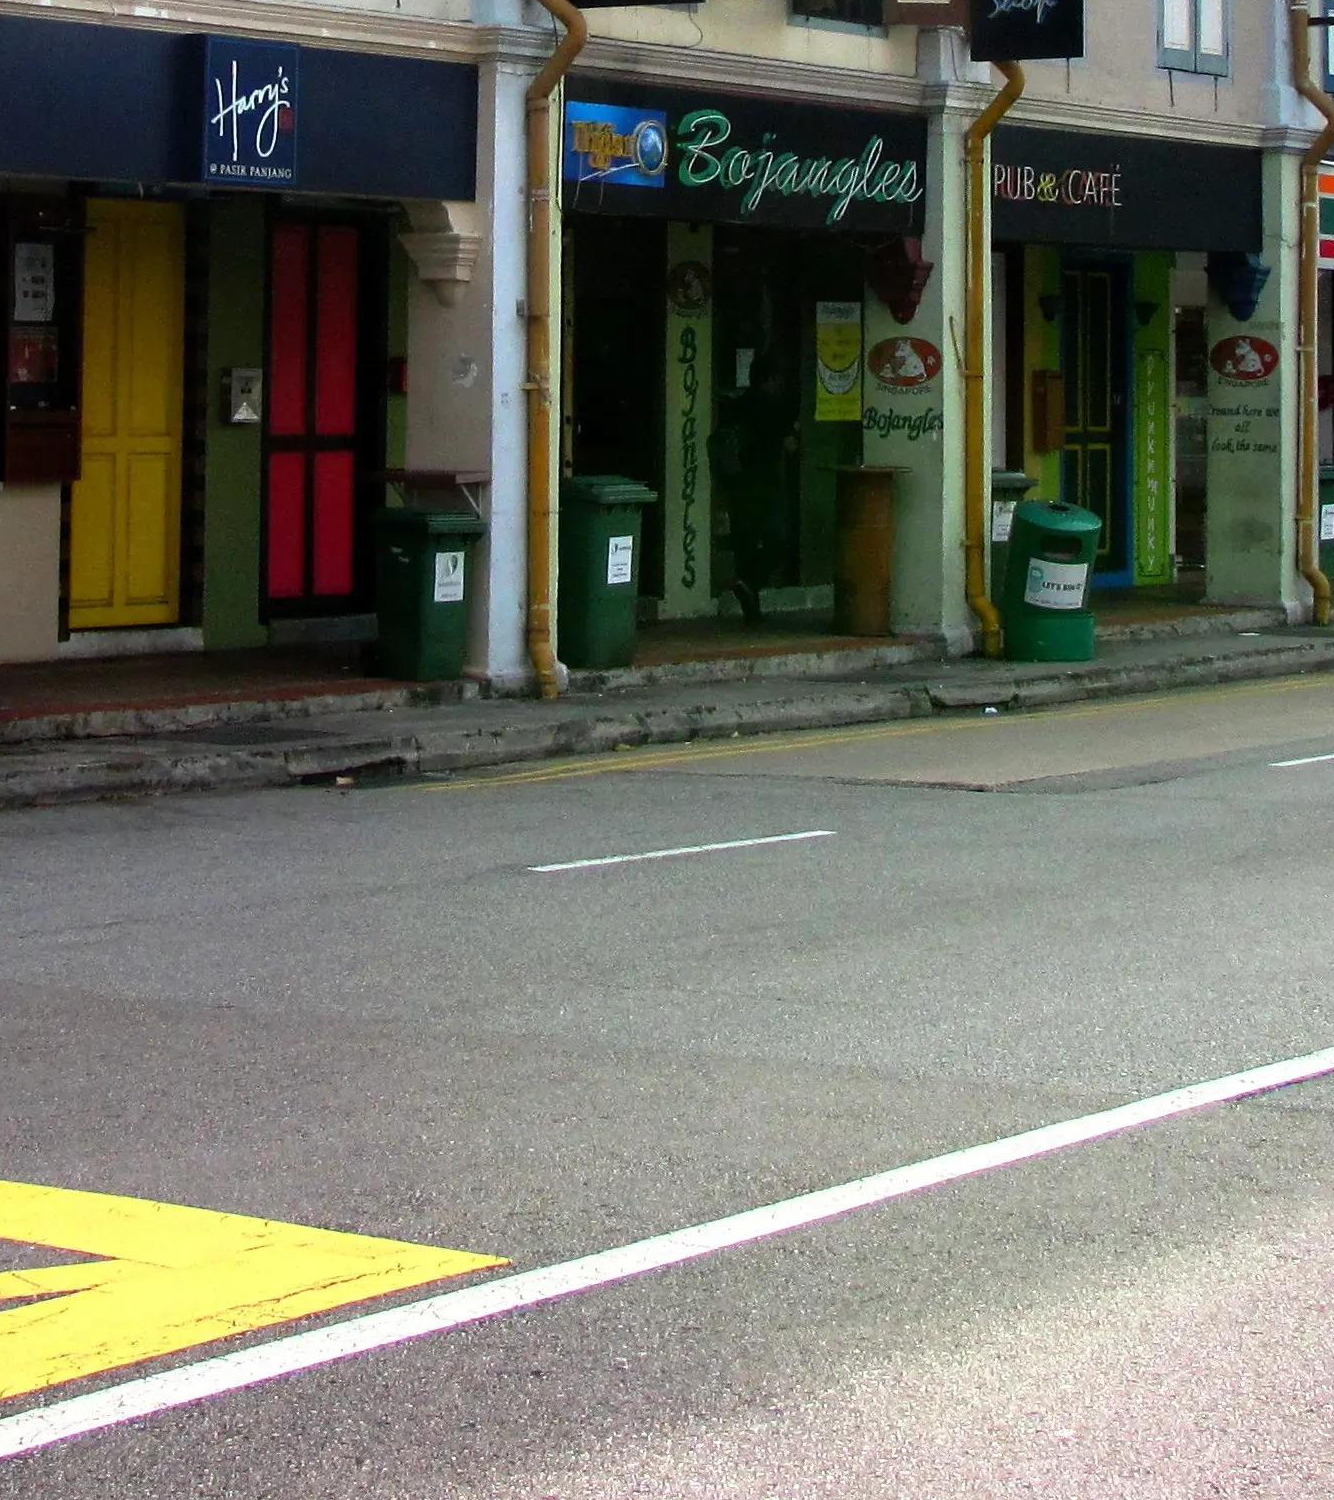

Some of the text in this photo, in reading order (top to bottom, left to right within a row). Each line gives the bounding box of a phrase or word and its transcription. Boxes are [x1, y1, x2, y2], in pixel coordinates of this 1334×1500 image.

[211, 60, 291, 162] Harry's
[220, 164, 248, 177] PASIR
[249, 166, 293, 180] PANJANG
[679, 108, 924, 224] Bojangles
[994, 164, 1036, 200] PUB
[1037, 171, 1059, 202] &
